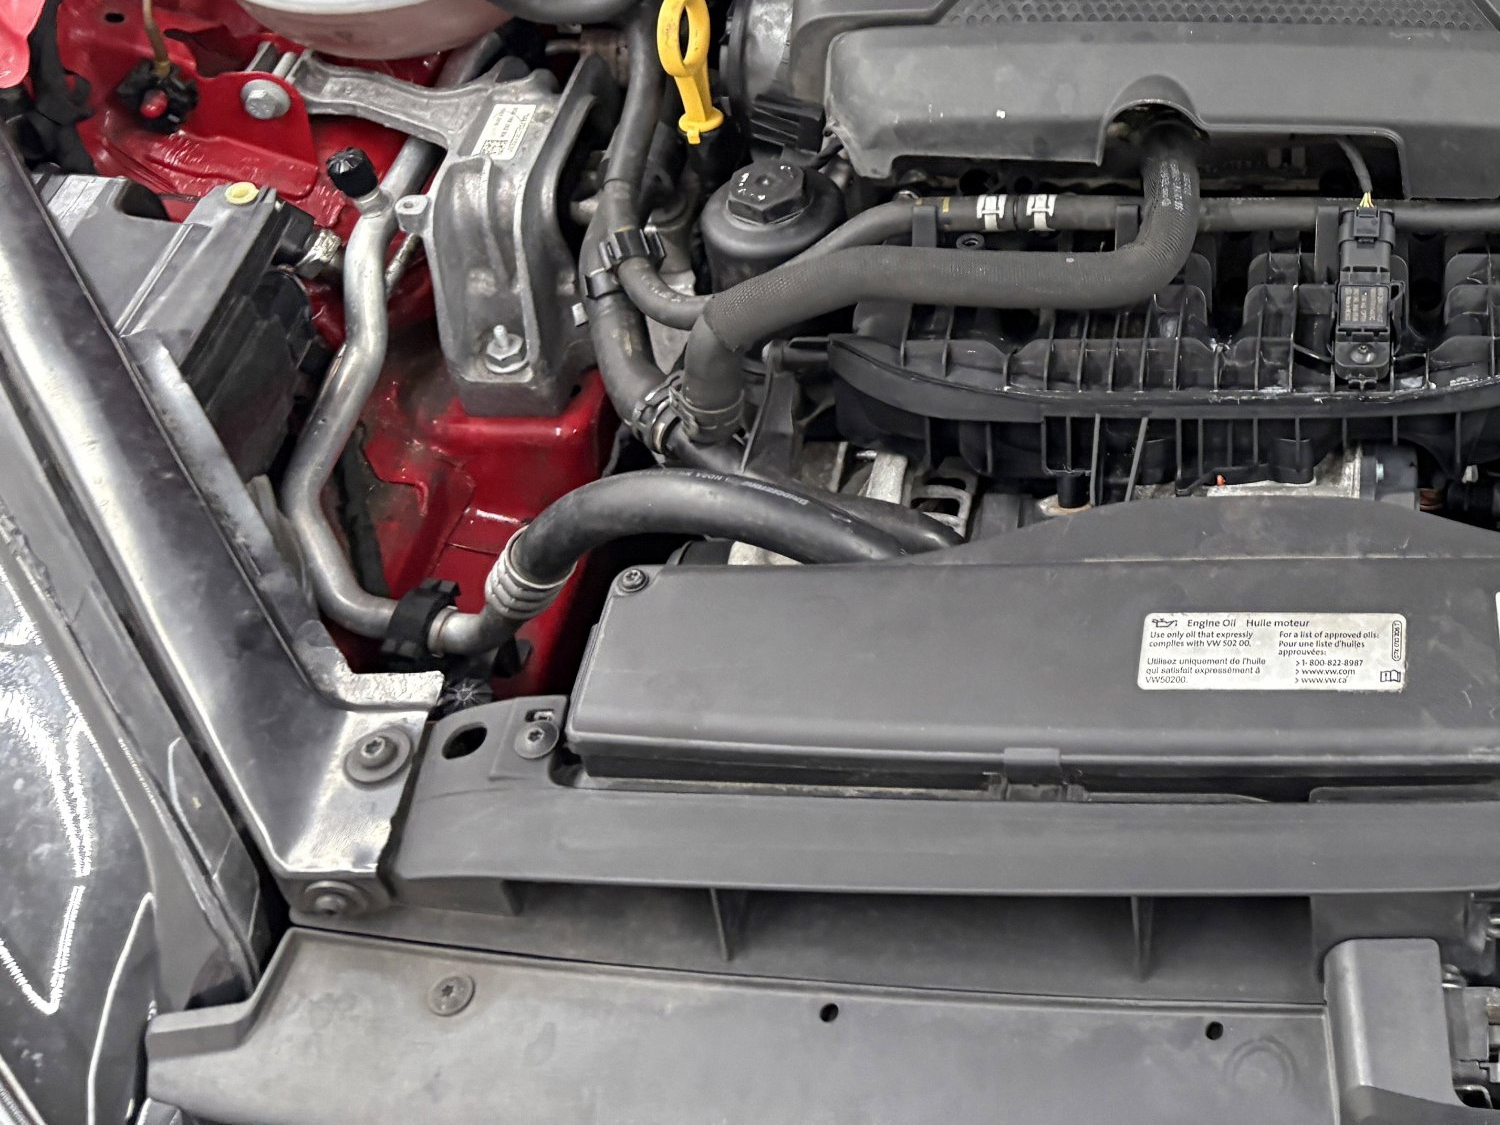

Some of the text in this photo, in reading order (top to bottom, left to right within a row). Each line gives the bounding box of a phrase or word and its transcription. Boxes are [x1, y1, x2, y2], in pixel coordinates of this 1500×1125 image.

[1187, 619, 1236, 629] Engine Oil
[1246, 619, 1310, 627] Huile moteur
[1167, 631, 1183, 640] only
[1216, 631, 1253, 640] expressly
[1280, 631, 1292, 639] For
[1300, 631, 1312, 639] list
[1314, 631, 1323, 639] of
[1325, 631, 1362, 641] approved
[1364, 631, 1380, 639] oils:
[1149, 640, 1184, 649] complies
[1186, 639, 1204, 647] with
[1334, 640, 1365, 648] d'huiles
[1278, 648, 1326, 657] approuvées:
[1179, 658, 1228, 666] uniquement
[1230, 657, 1240, 665] de
[1242, 657, 1266, 665] l'huile
[1146, 667, 1158, 676] qui
[1194, 667, 1253, 675] expressément
